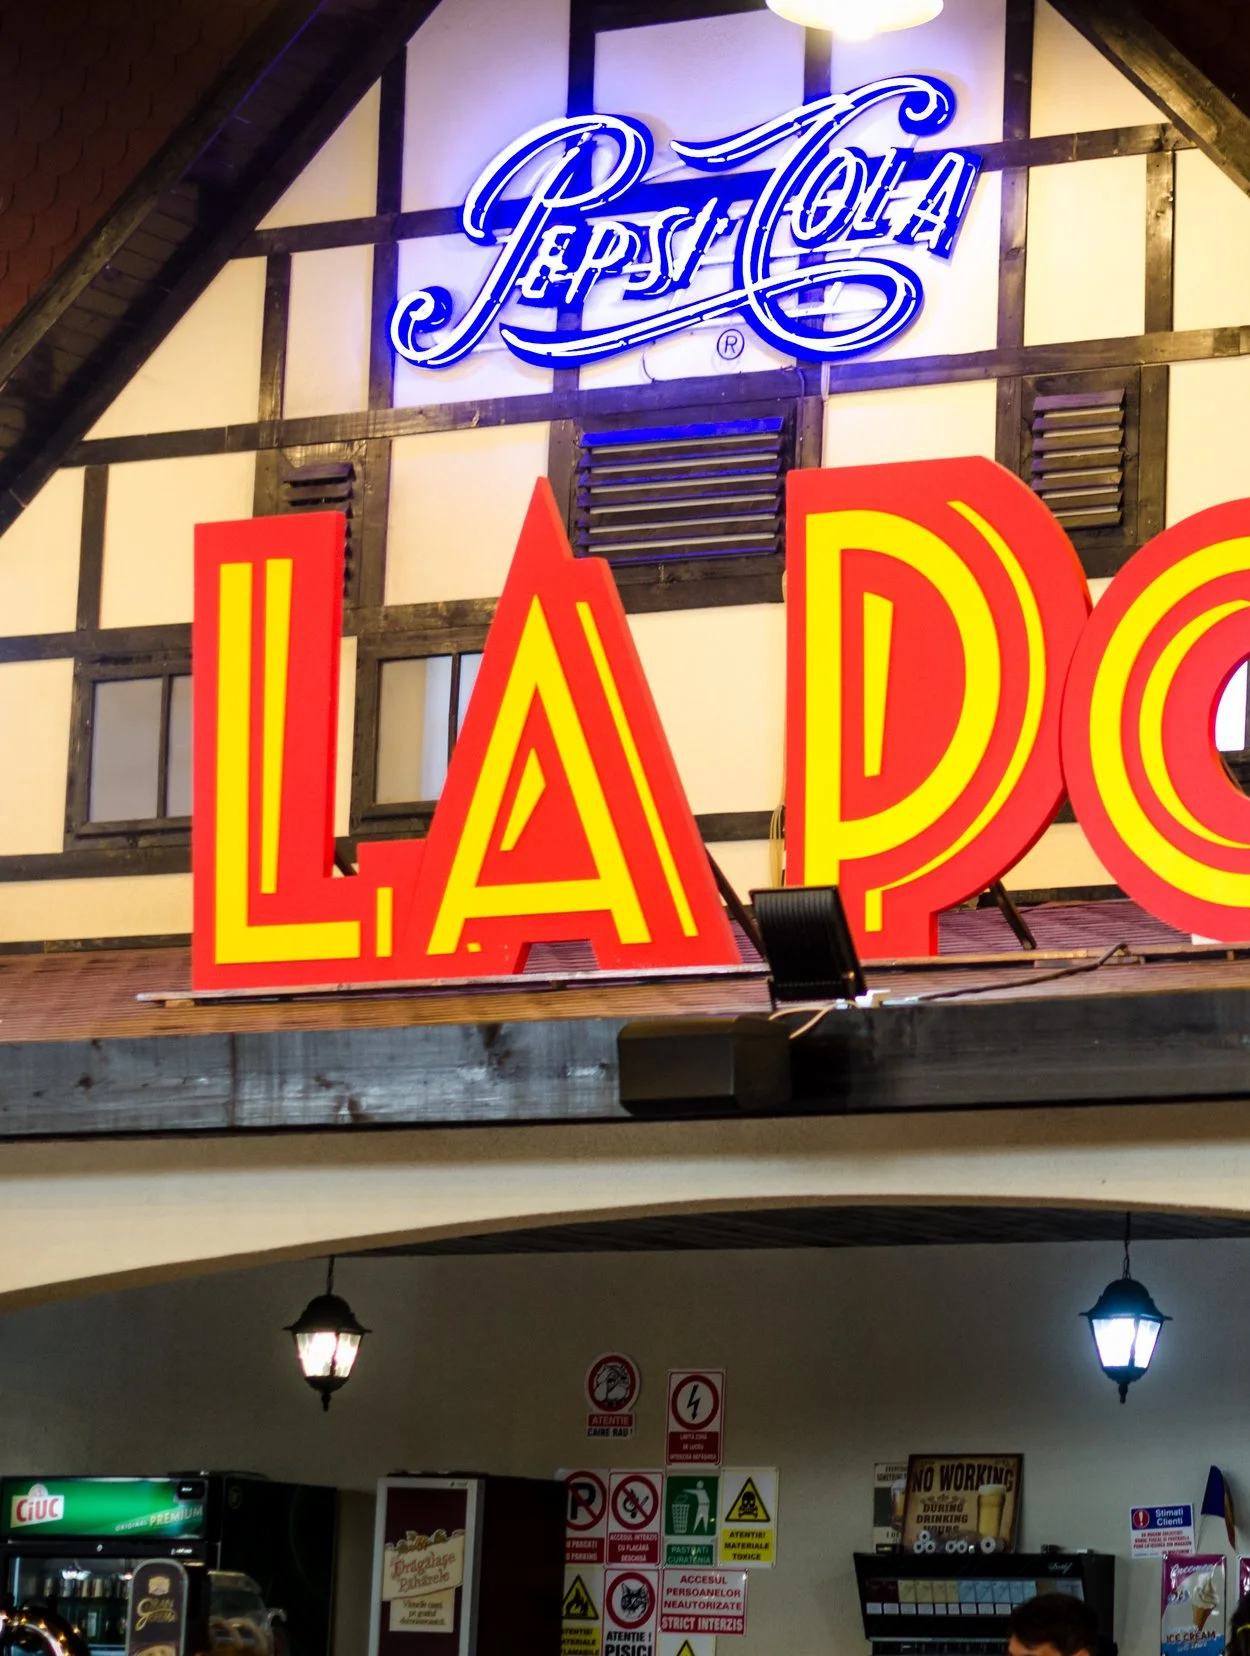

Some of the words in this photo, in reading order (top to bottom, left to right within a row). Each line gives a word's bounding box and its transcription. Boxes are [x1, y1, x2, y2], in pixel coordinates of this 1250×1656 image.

[911, 1465, 934, 1493] NO
[939, 1462, 1015, 1492] WORKING
[922, 1503, 964, 1513] DURING
[148, 1504, 203, 1526] PREMIUM
[916, 1514, 968, 1524] DRINKING
[1156, 1517, 1183, 1527] Clienti
[724, 1542, 770, 1550] MATERIALE
[732, 1552, 762, 1561] TOXICE
[680, 1575, 728, 1584] ACCESUL
[666, 1588, 741, 1597] PERSOANELOR
[664, 1600, 742, 1610] NEAUTORIZATE
[661, 1615, 695, 1630] STRICT
[697, 1616, 743, 1632] INTERZIS
